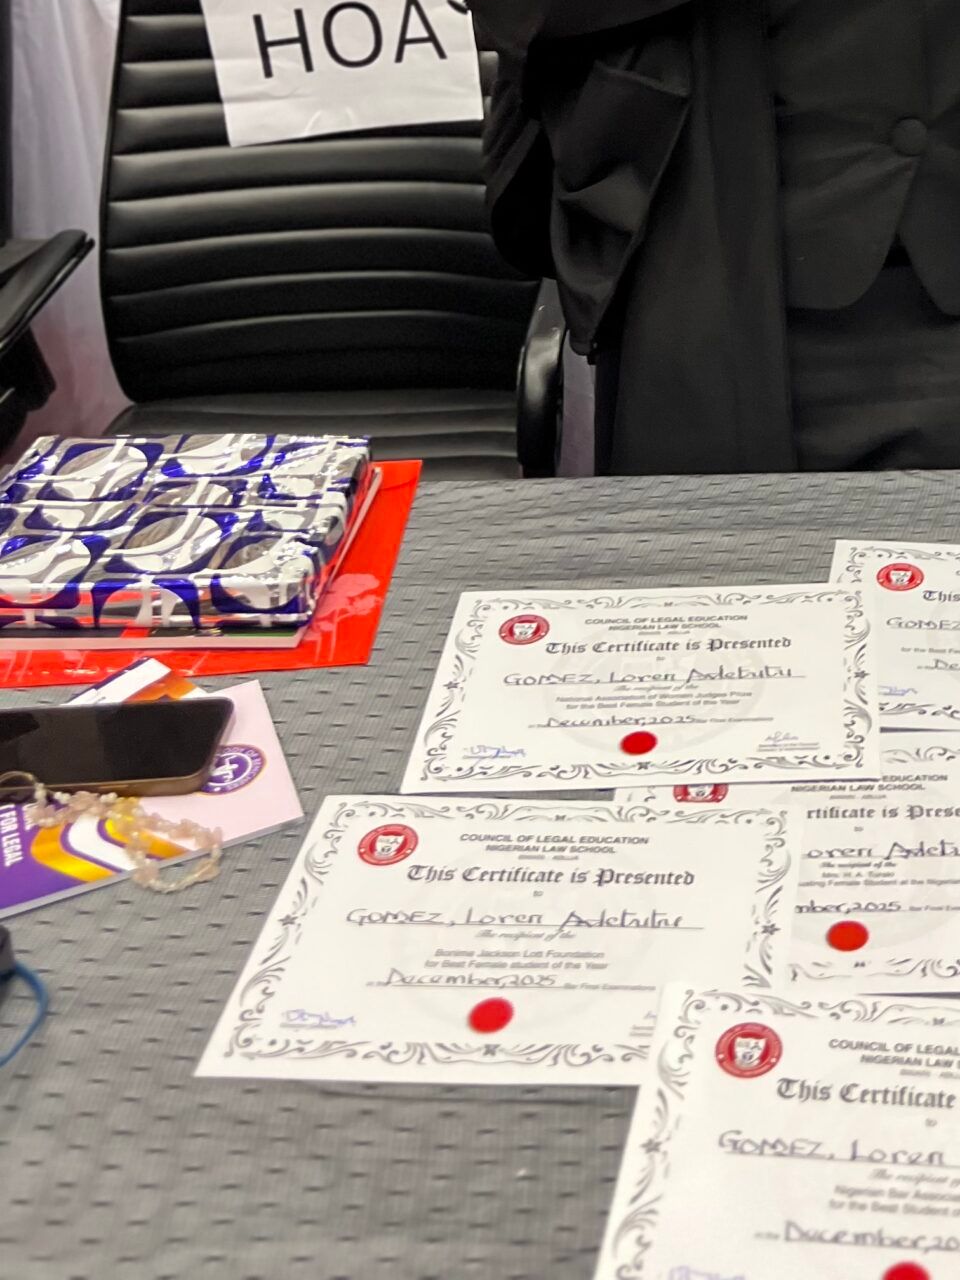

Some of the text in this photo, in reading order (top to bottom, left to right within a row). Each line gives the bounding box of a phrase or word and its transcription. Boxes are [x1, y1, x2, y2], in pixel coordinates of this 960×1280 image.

[545, 637, 791, 655] This Certificate is Presented
[609, 672, 676, 683] Loren
[806, 808, 875, 819] rtificate
[882, 807, 899, 818] is
[460, 834, 512, 842] COUNCIL
[536, 835, 575, 843] LEGAL
[579, 836, 649, 844] EDUCATION
[2, 832, 23, 867] LEGAL
[807, 847, 873, 858] oren
[407, 864, 695, 886] This Certificate is Presented
[466, 907, 543, 925] Loren
[828, 1039, 890, 1052] COUNCIL
[894, 1043, 913, 1054] OF
[916, 1044, 960, 1056] LEGAL
[860, 1054, 923, 1066] NIGERIAN
[925, 1057, 954, 1068] LAW
[776, 1077, 832, 1102] This
[839, 1082, 957, 1109] Certificate
[850, 1140, 945, 1166] Loren
